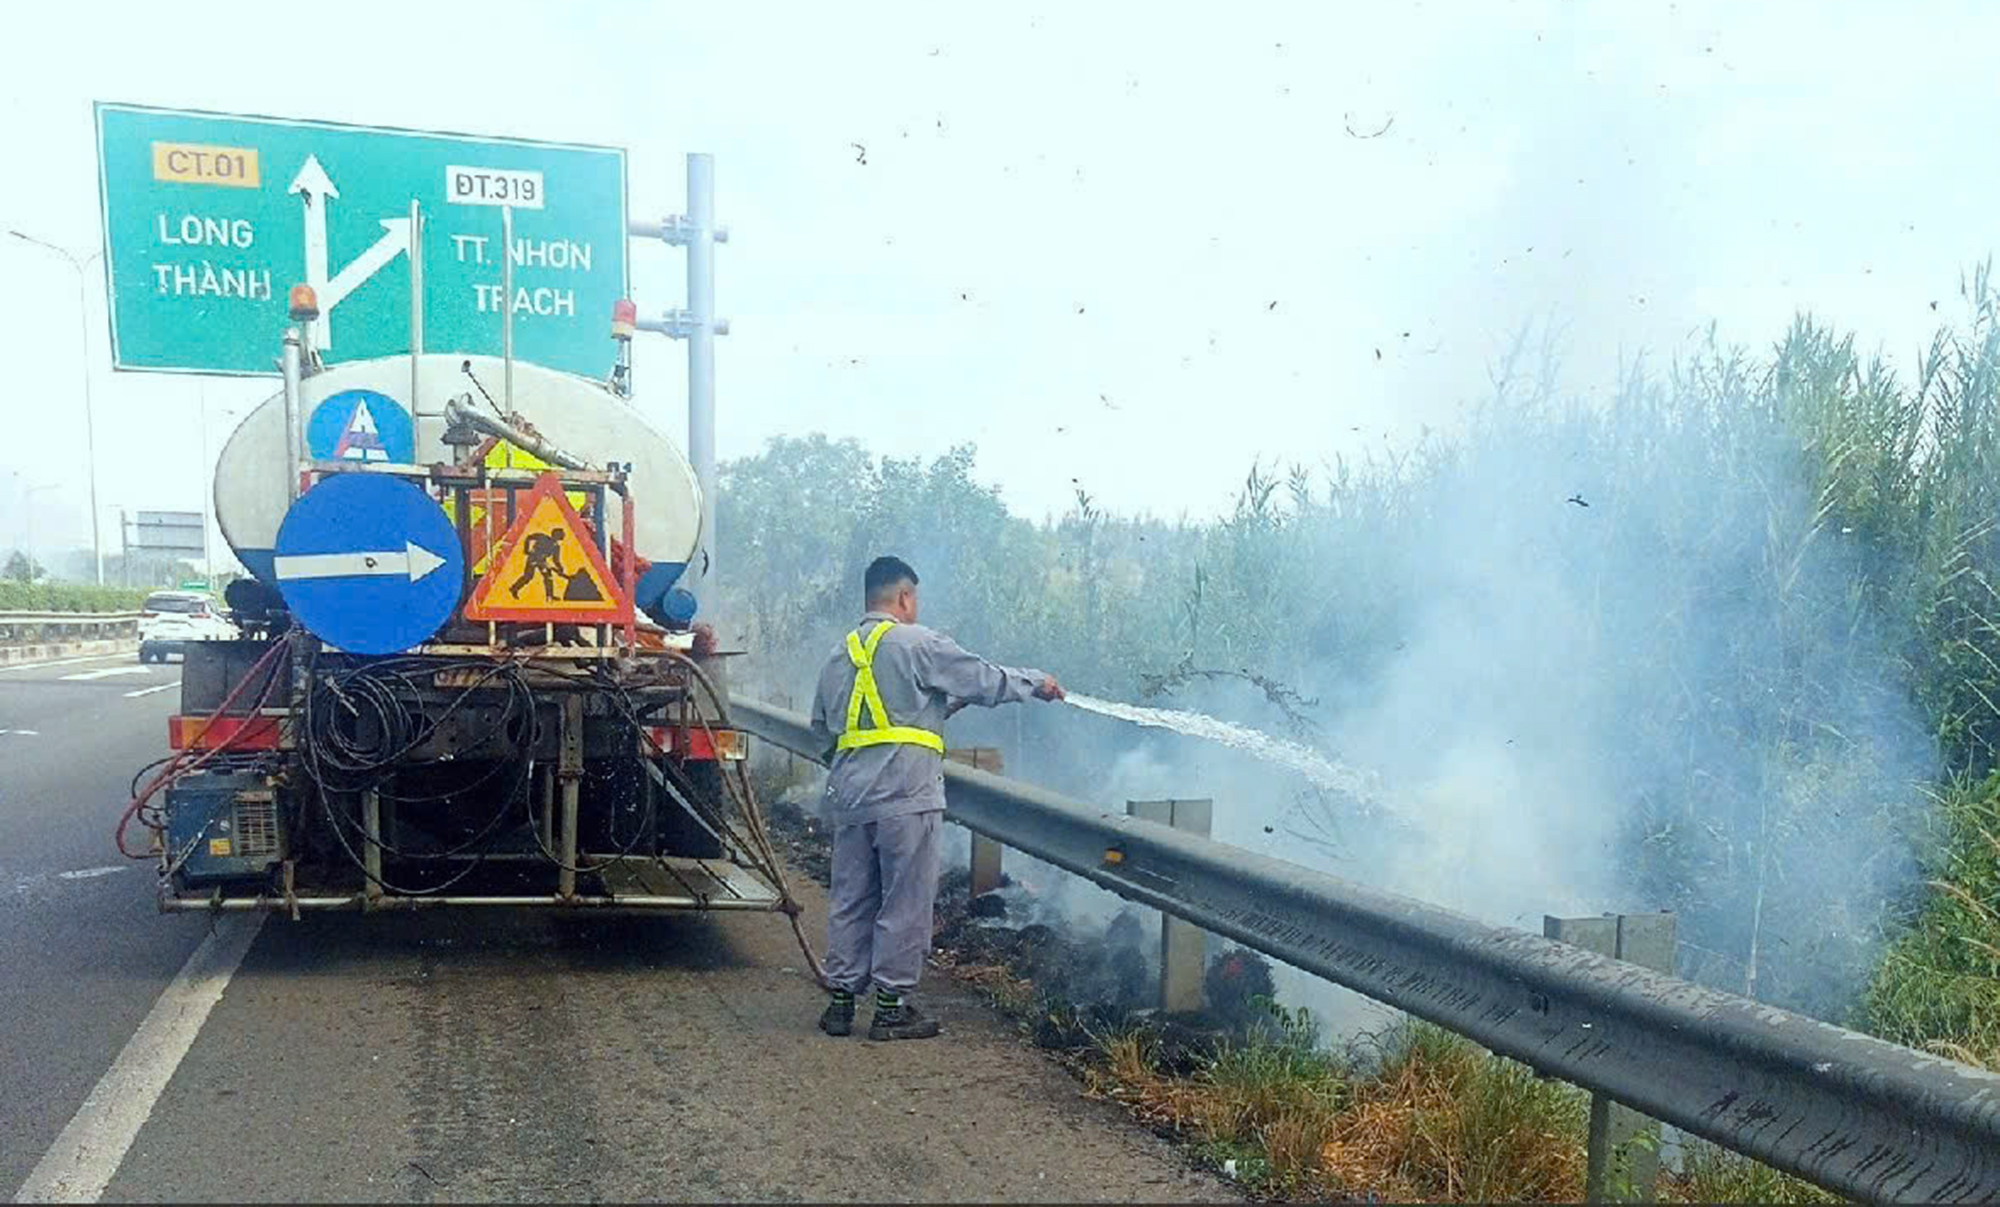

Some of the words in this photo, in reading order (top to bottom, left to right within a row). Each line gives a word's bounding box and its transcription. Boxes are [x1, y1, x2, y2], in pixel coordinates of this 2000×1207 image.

[168, 150, 245, 179] CT.01
[456, 173, 536, 200] ĐT.319
[158, 214, 254, 248] LONG
[450, 233, 493, 265] TT.
[506, 237, 592, 272] NHƠN
[152, 260, 271, 301] THÀNH
